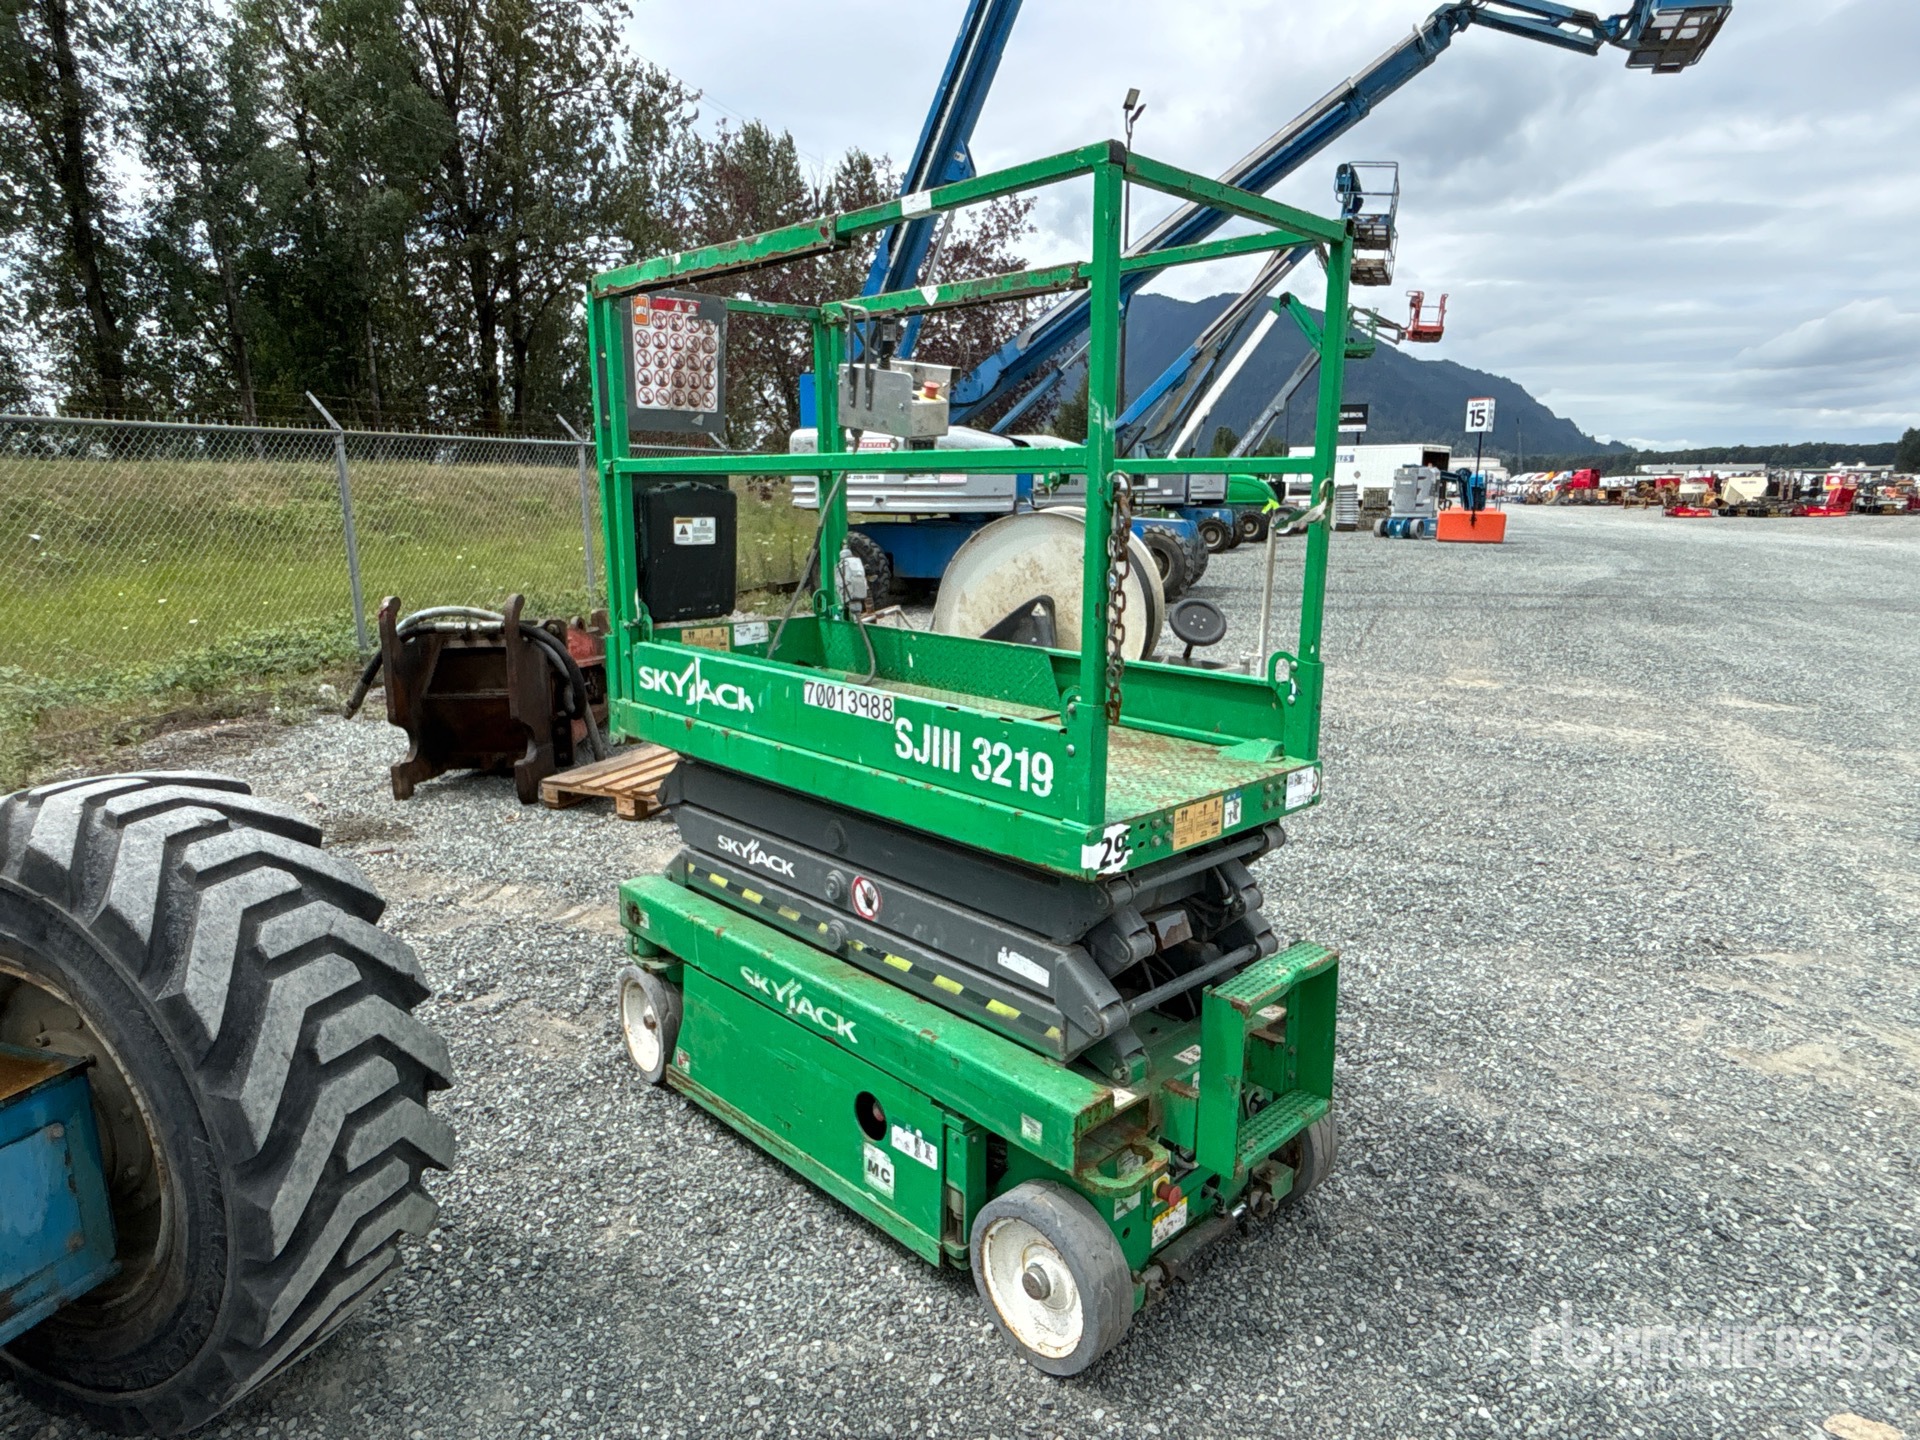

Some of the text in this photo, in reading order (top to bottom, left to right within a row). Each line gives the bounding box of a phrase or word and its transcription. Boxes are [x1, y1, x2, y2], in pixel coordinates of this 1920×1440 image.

[1469, 409, 1486, 427] 15
[638, 657, 754, 714] SKYJACK
[804, 681, 893, 722] 70013988
[971, 737, 1054, 797] 3219
[717, 834, 795, 878] SKYJACK
[740, 965, 858, 1044] SKYJACK
[867, 1158, 891, 1184] MC
